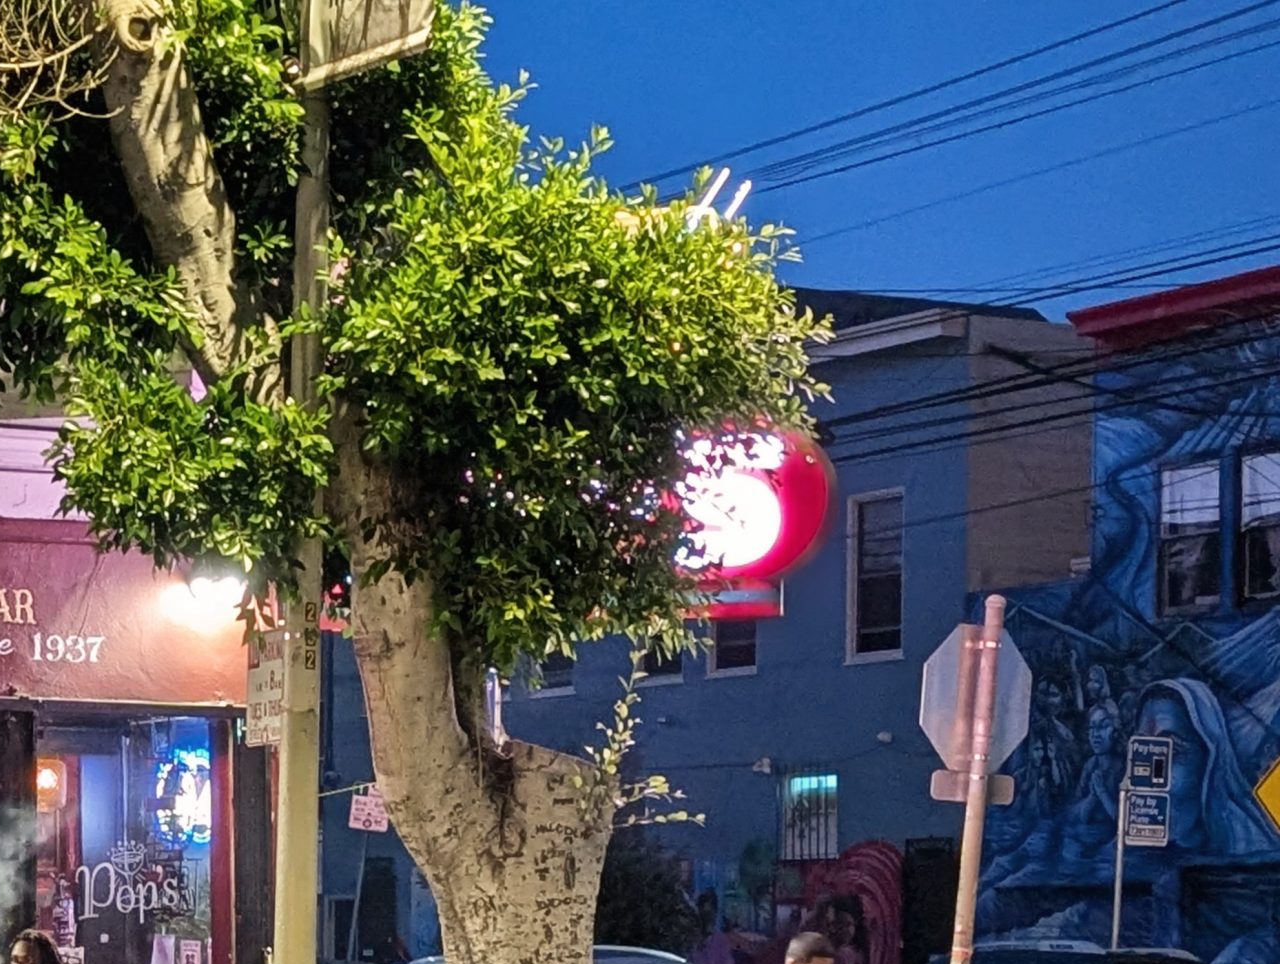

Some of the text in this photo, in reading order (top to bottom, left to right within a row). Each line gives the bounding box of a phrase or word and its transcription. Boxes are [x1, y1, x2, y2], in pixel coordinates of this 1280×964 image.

[32, 632, 105, 663] 1937
[1130, 795, 1145, 807] Pay
[75, 862, 179, 924] Pop's
